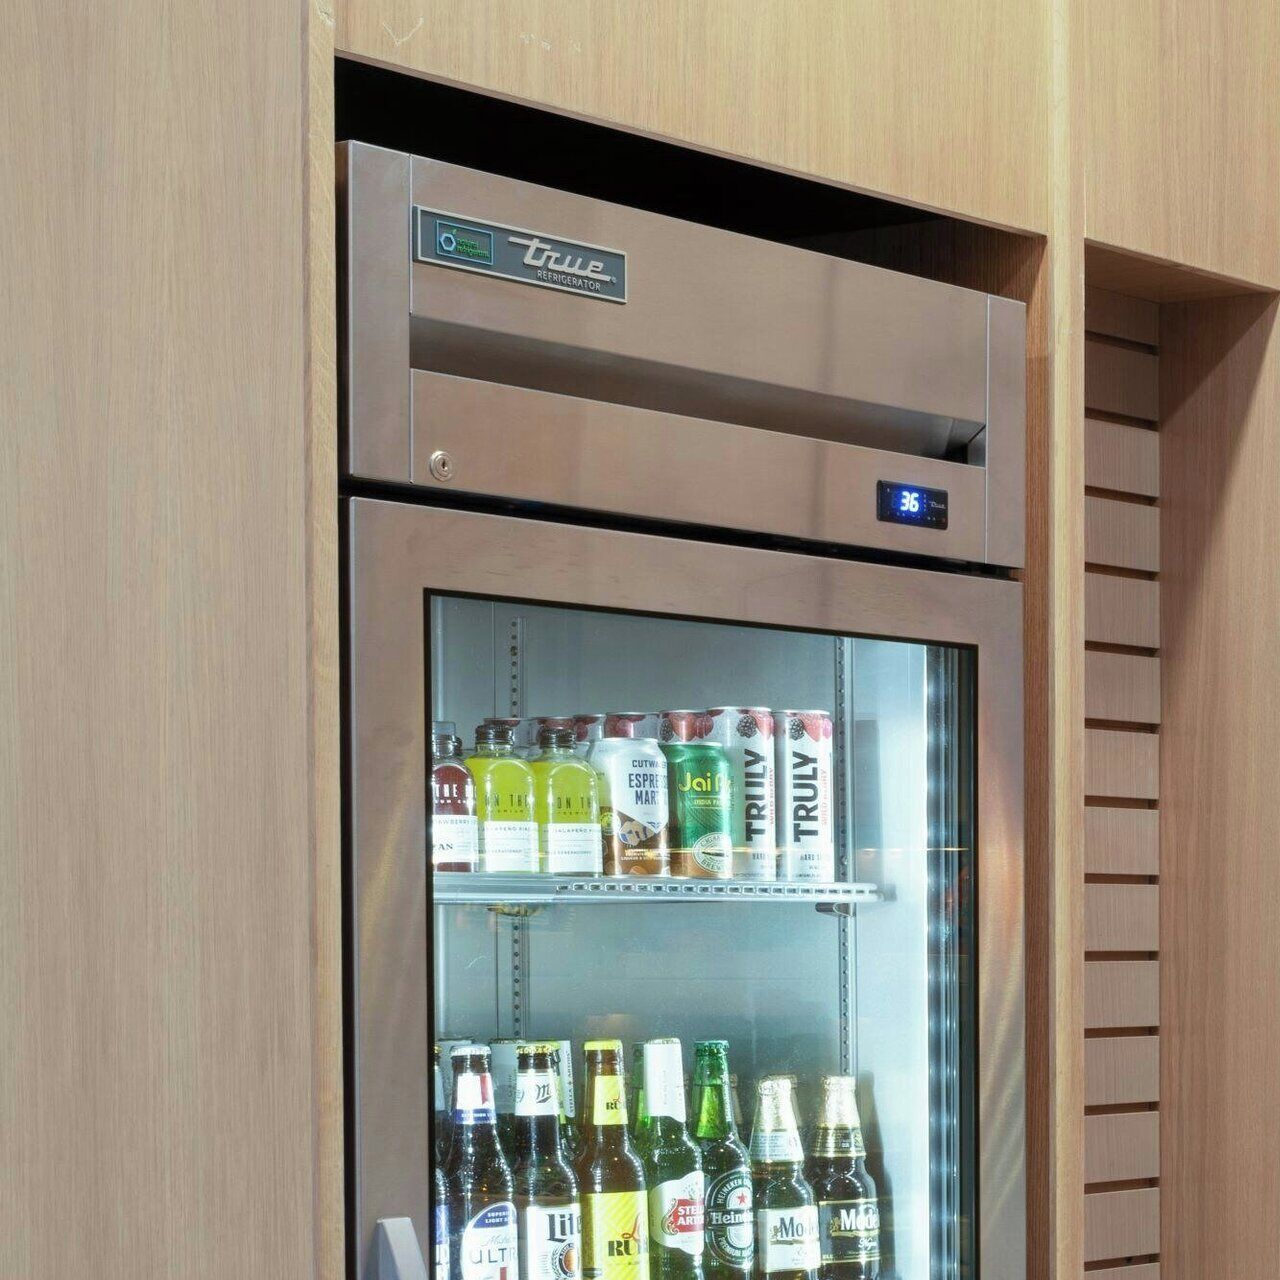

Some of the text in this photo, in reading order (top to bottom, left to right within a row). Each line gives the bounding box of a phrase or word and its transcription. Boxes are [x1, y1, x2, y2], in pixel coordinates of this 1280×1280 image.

[537, 270, 601, 291] REFRIGERATOR
[900, 491, 919, 512] 36
[678, 772, 711, 792] Jai
[635, 790, 659, 805] MAR
[744, 748, 767, 842] TRULY
[792, 751, 818, 842] TRULY
